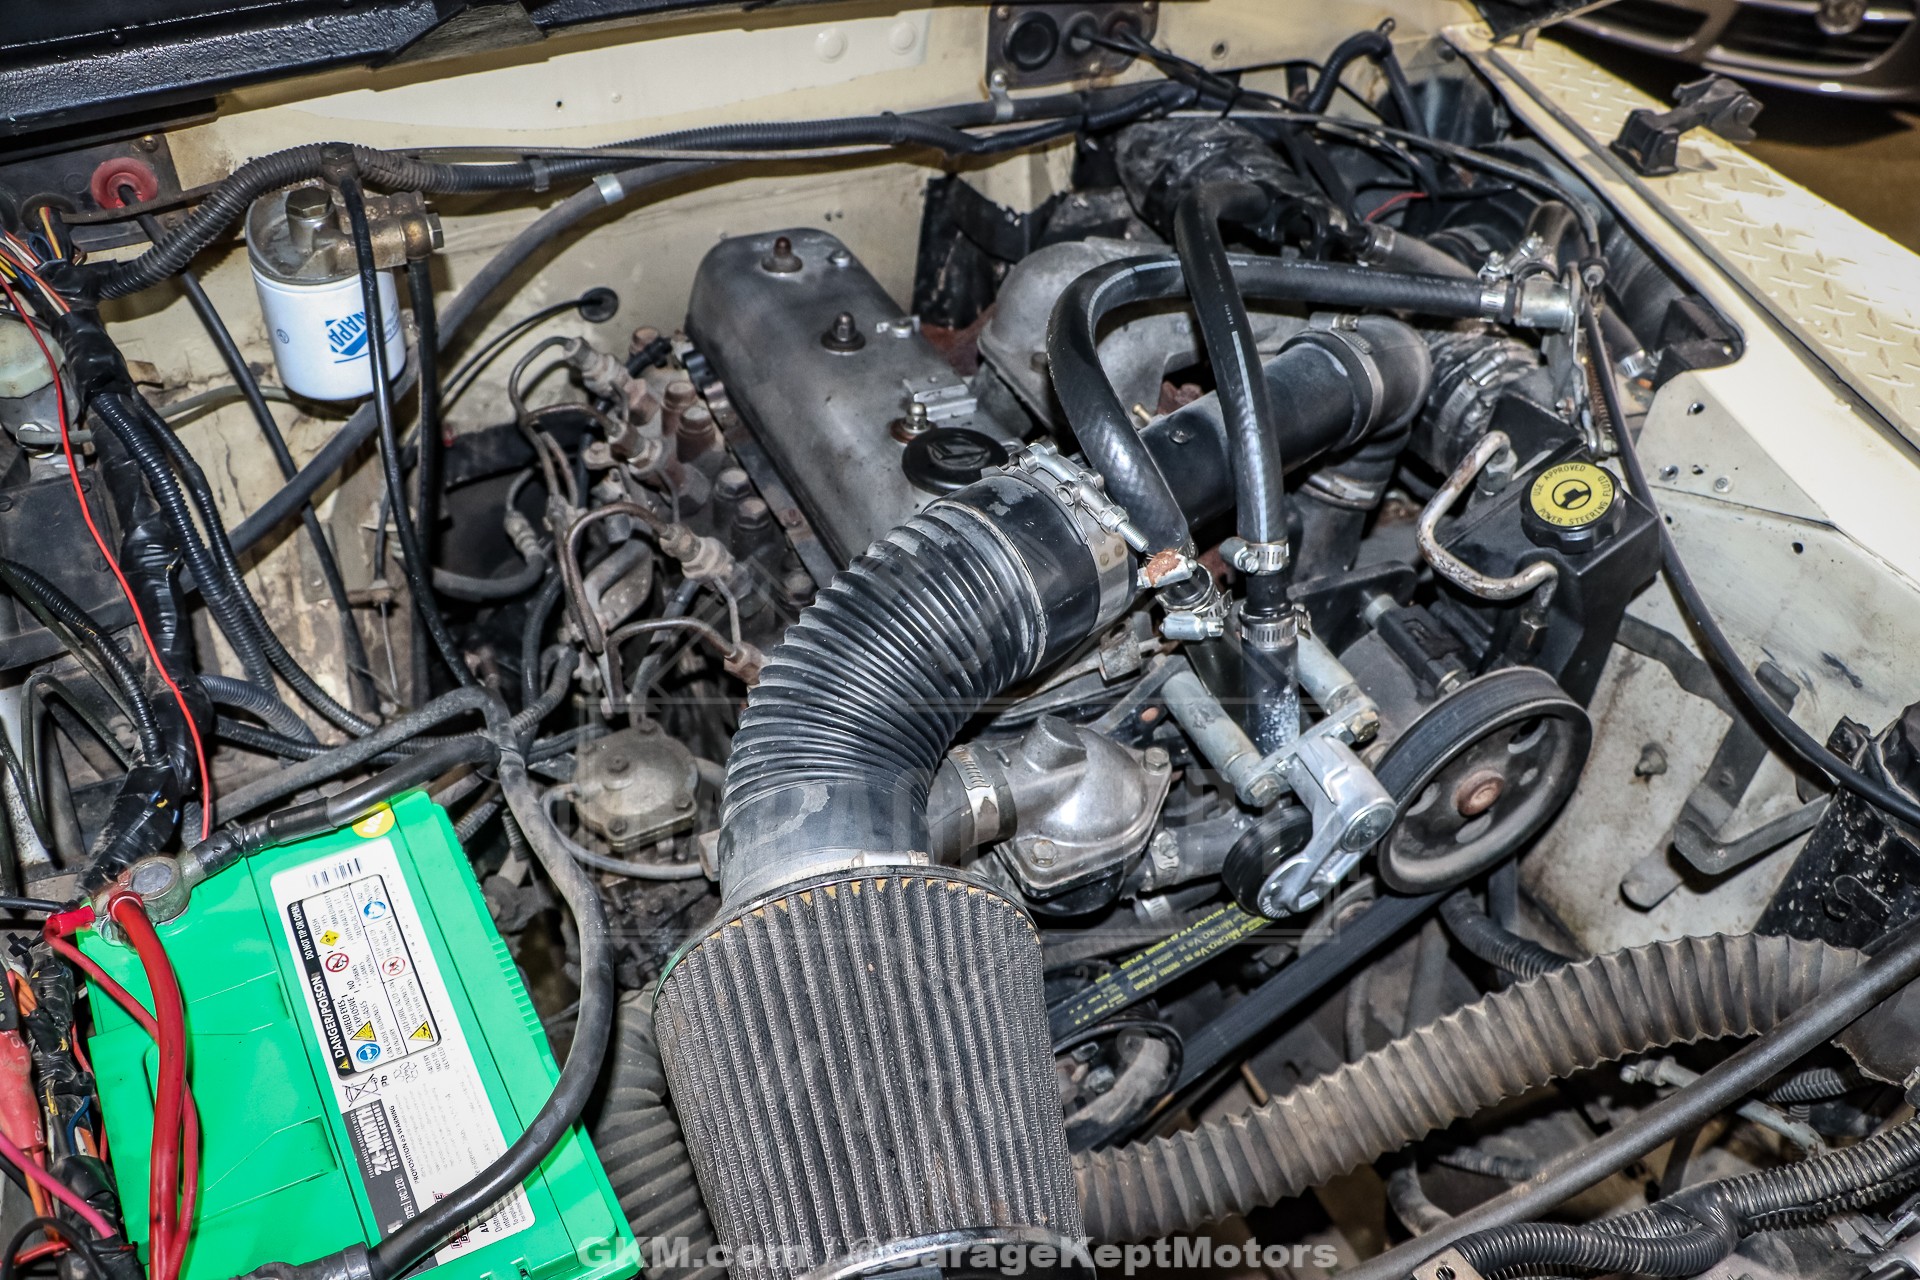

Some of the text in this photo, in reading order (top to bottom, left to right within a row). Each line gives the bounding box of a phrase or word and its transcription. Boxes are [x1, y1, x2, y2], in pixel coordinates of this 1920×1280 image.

[1533, 464, 1586, 496] USE APPROVED
[1538, 475, 1611, 525] POWER STEERING FLUID
[293, 918, 305, 930] OR
[296, 927, 307, 939] TIP
[299, 936, 311, 951] NOT
[303, 948, 315, 960] DO
[346, 979, 356, 990] NO
[309, 974, 345, 1058] DANGER/POISON
[336, 998, 355, 1035] SHIELD EYES
[346, 996, 363, 1027] EXPLOSIVE
[359, 999, 371, 1019] GASES
[387, 1104, 403, 1134] WARNING
[355, 1105, 392, 1176] 24-MONTH
[371, 1103, 400, 1169] FREE REPLACEMENT
[393, 1177, 406, 1191] 120
[398, 1189, 409, 1201] RC
